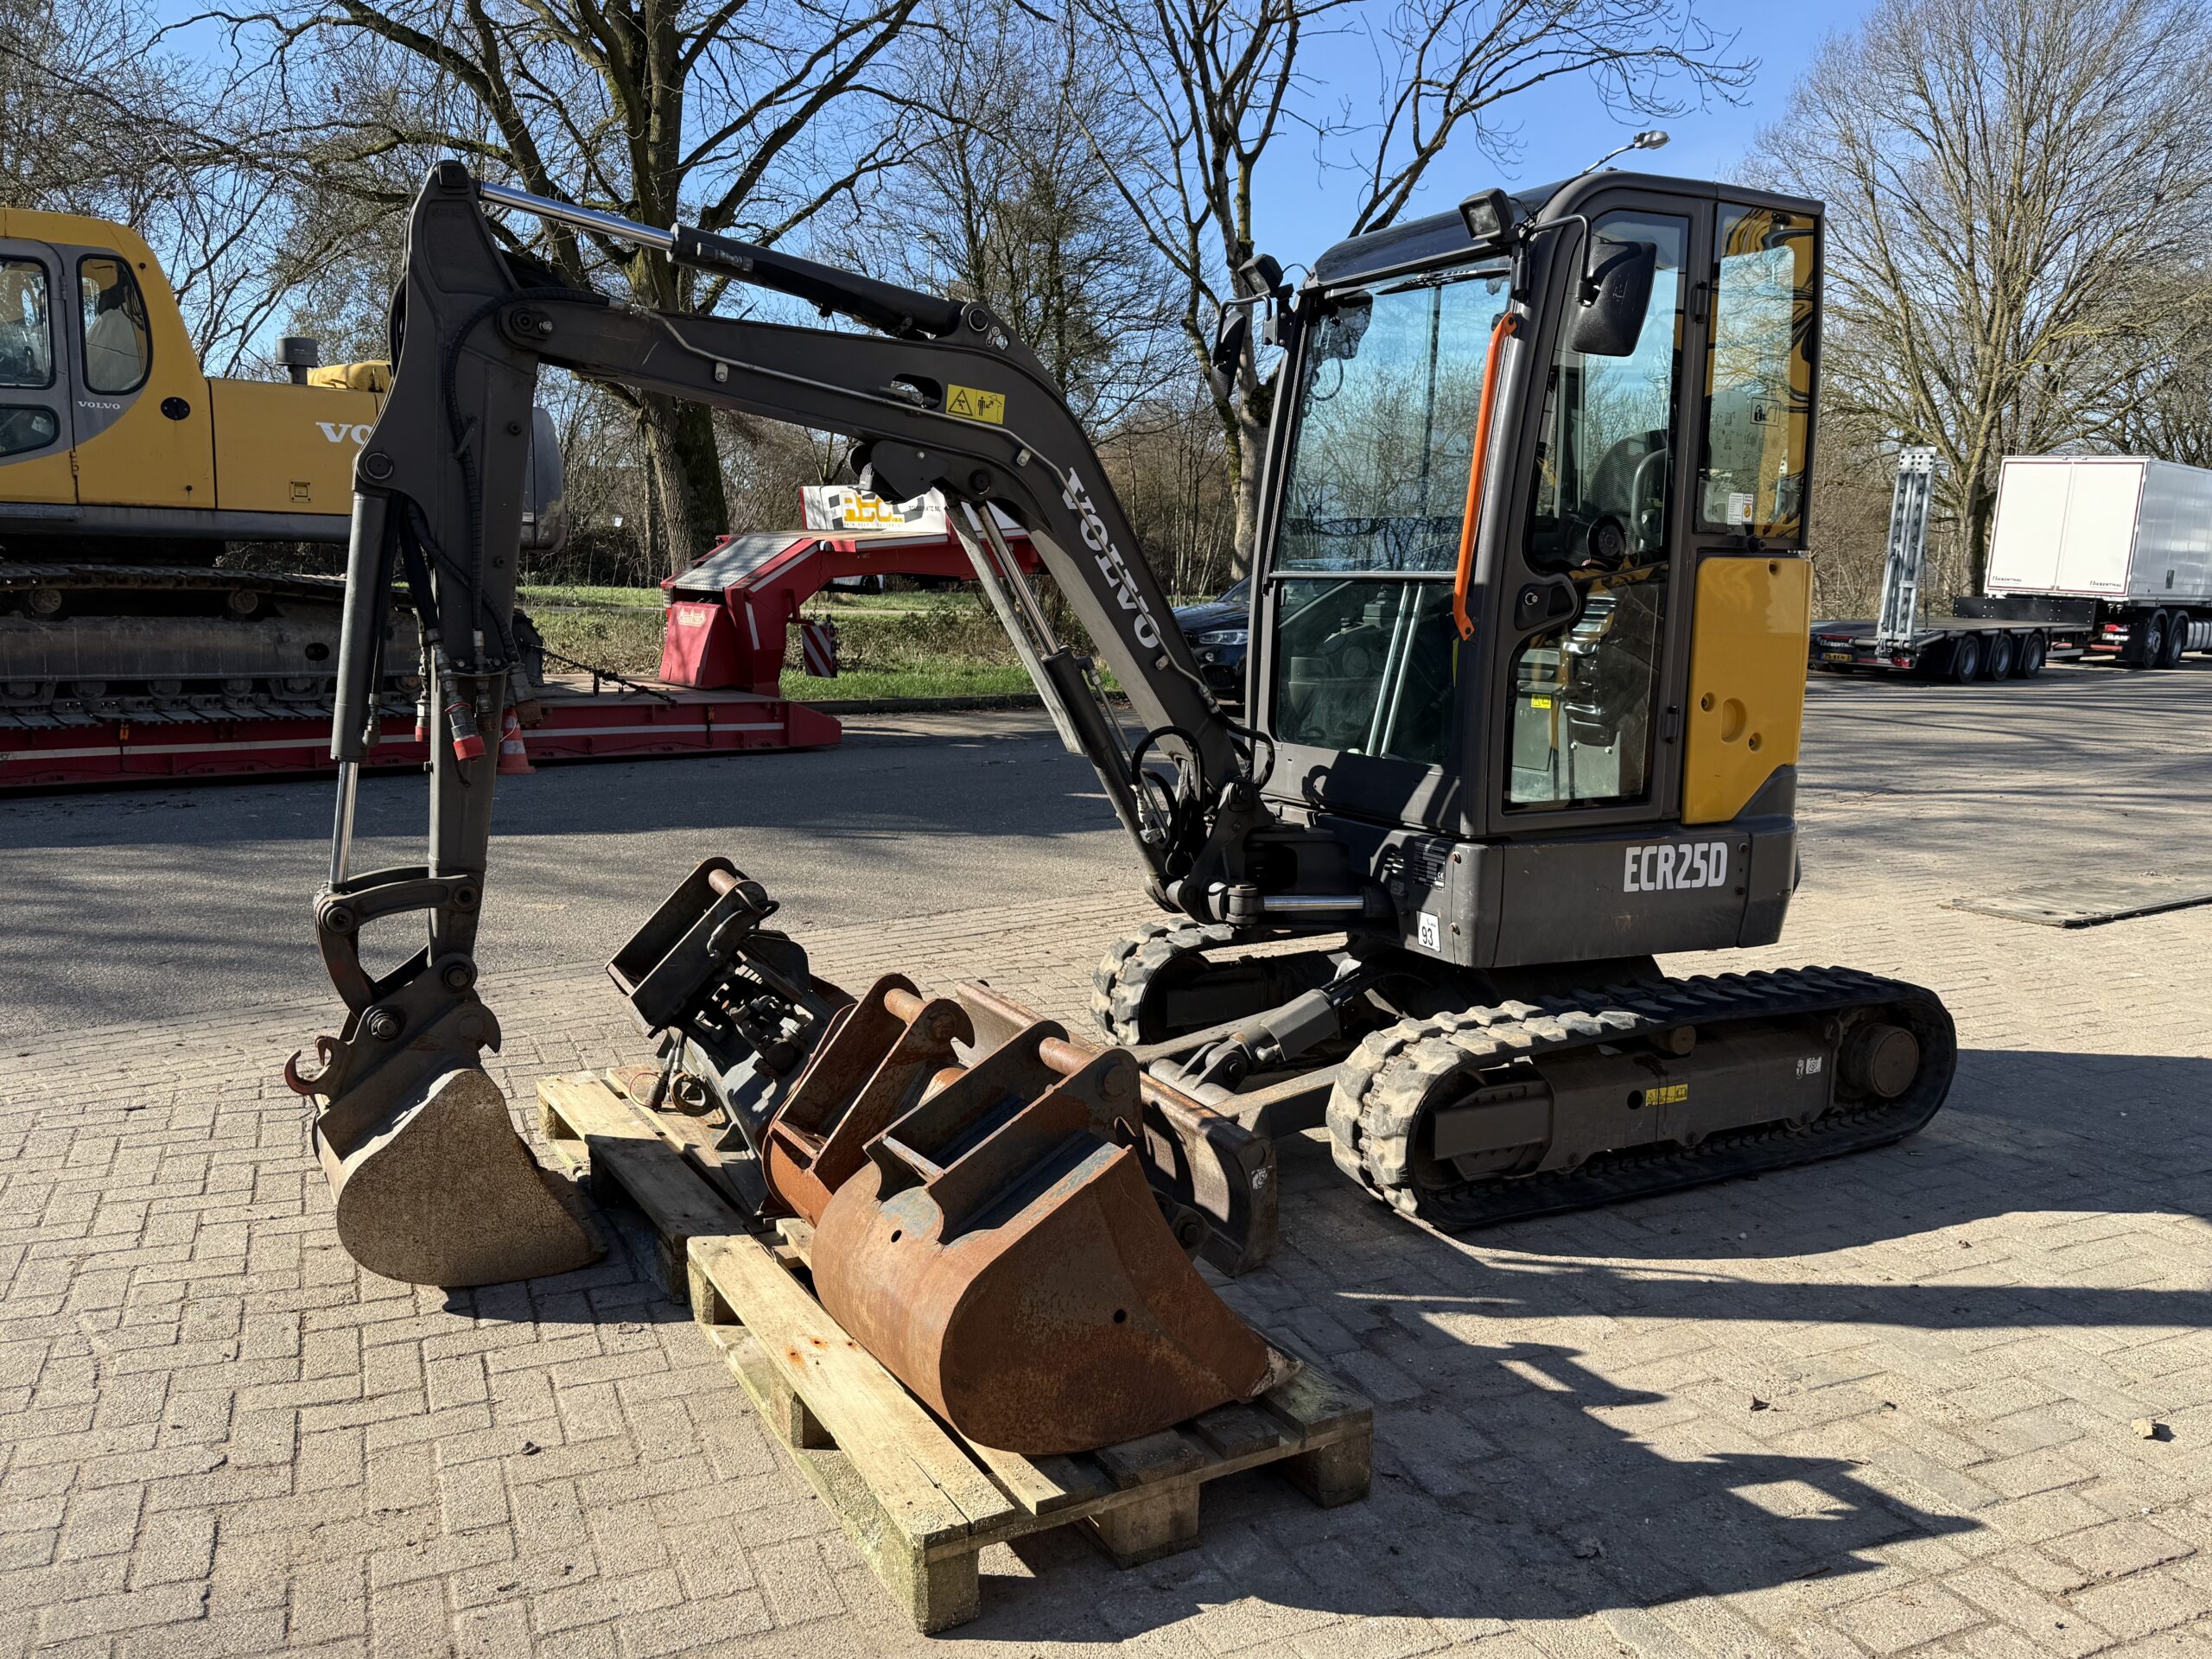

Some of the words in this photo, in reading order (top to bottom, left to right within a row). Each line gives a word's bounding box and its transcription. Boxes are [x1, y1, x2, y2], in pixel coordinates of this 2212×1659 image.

[77, 400, 121, 410] VOLVO
[1062, 467, 1160, 648] VOLVO
[1624, 842, 1728, 893] ECR25D
[1421, 925, 1433, 947] 93
